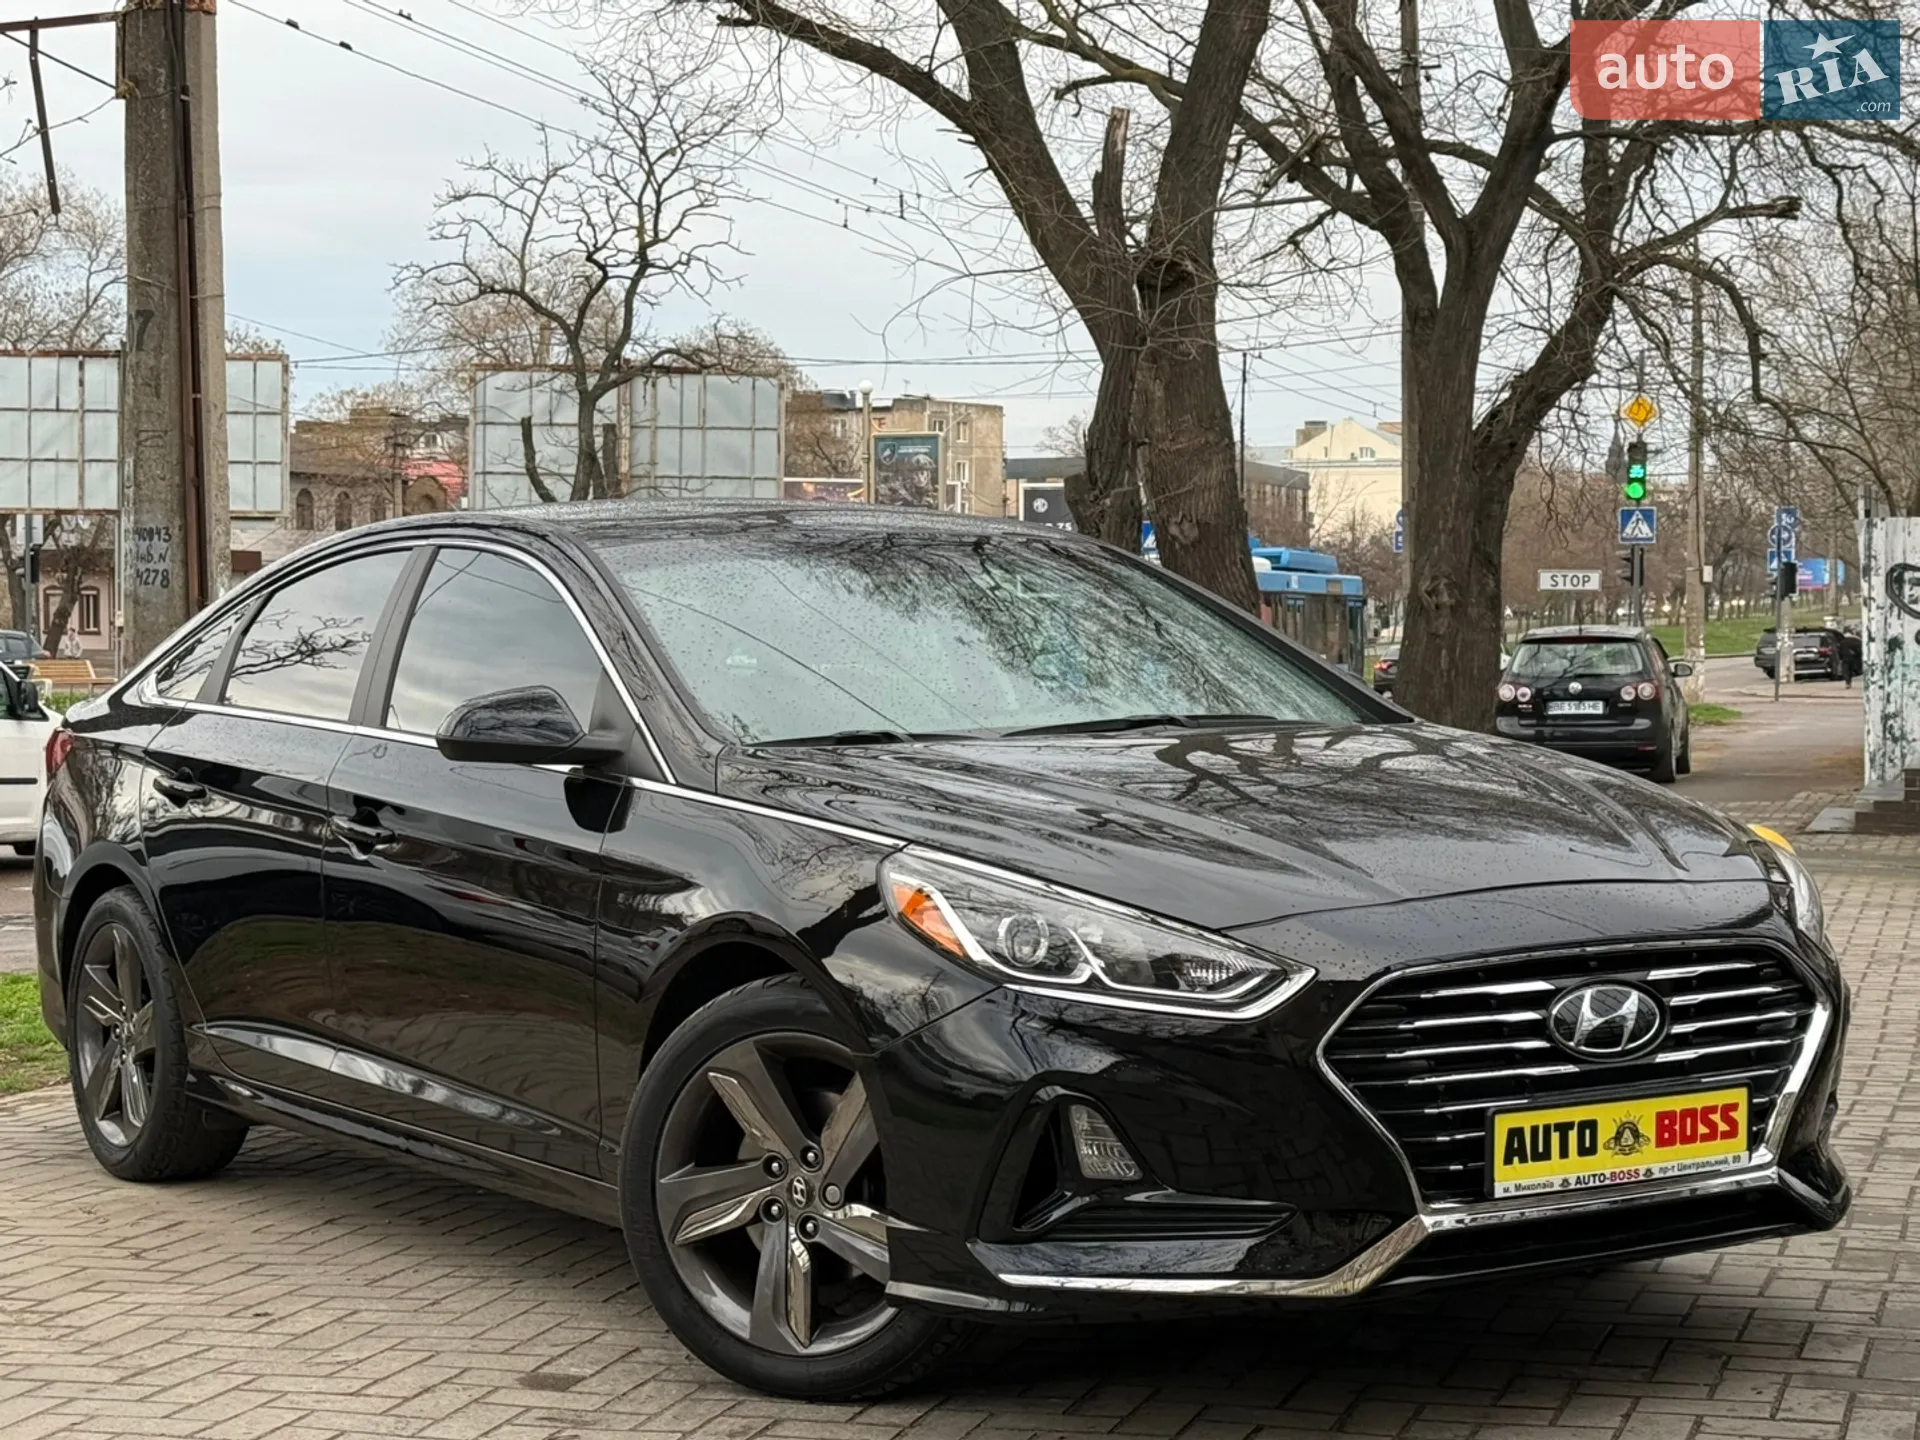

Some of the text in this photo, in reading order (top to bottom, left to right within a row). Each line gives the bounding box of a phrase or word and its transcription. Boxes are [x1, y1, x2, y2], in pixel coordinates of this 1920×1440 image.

[135, 567, 171, 589] 4278
[1549, 574, 1591, 588] STOP
[1503, 1102, 1740, 1167] AUTO BOSS
[1574, 1168, 1641, 1186] AUTO-BOSS
